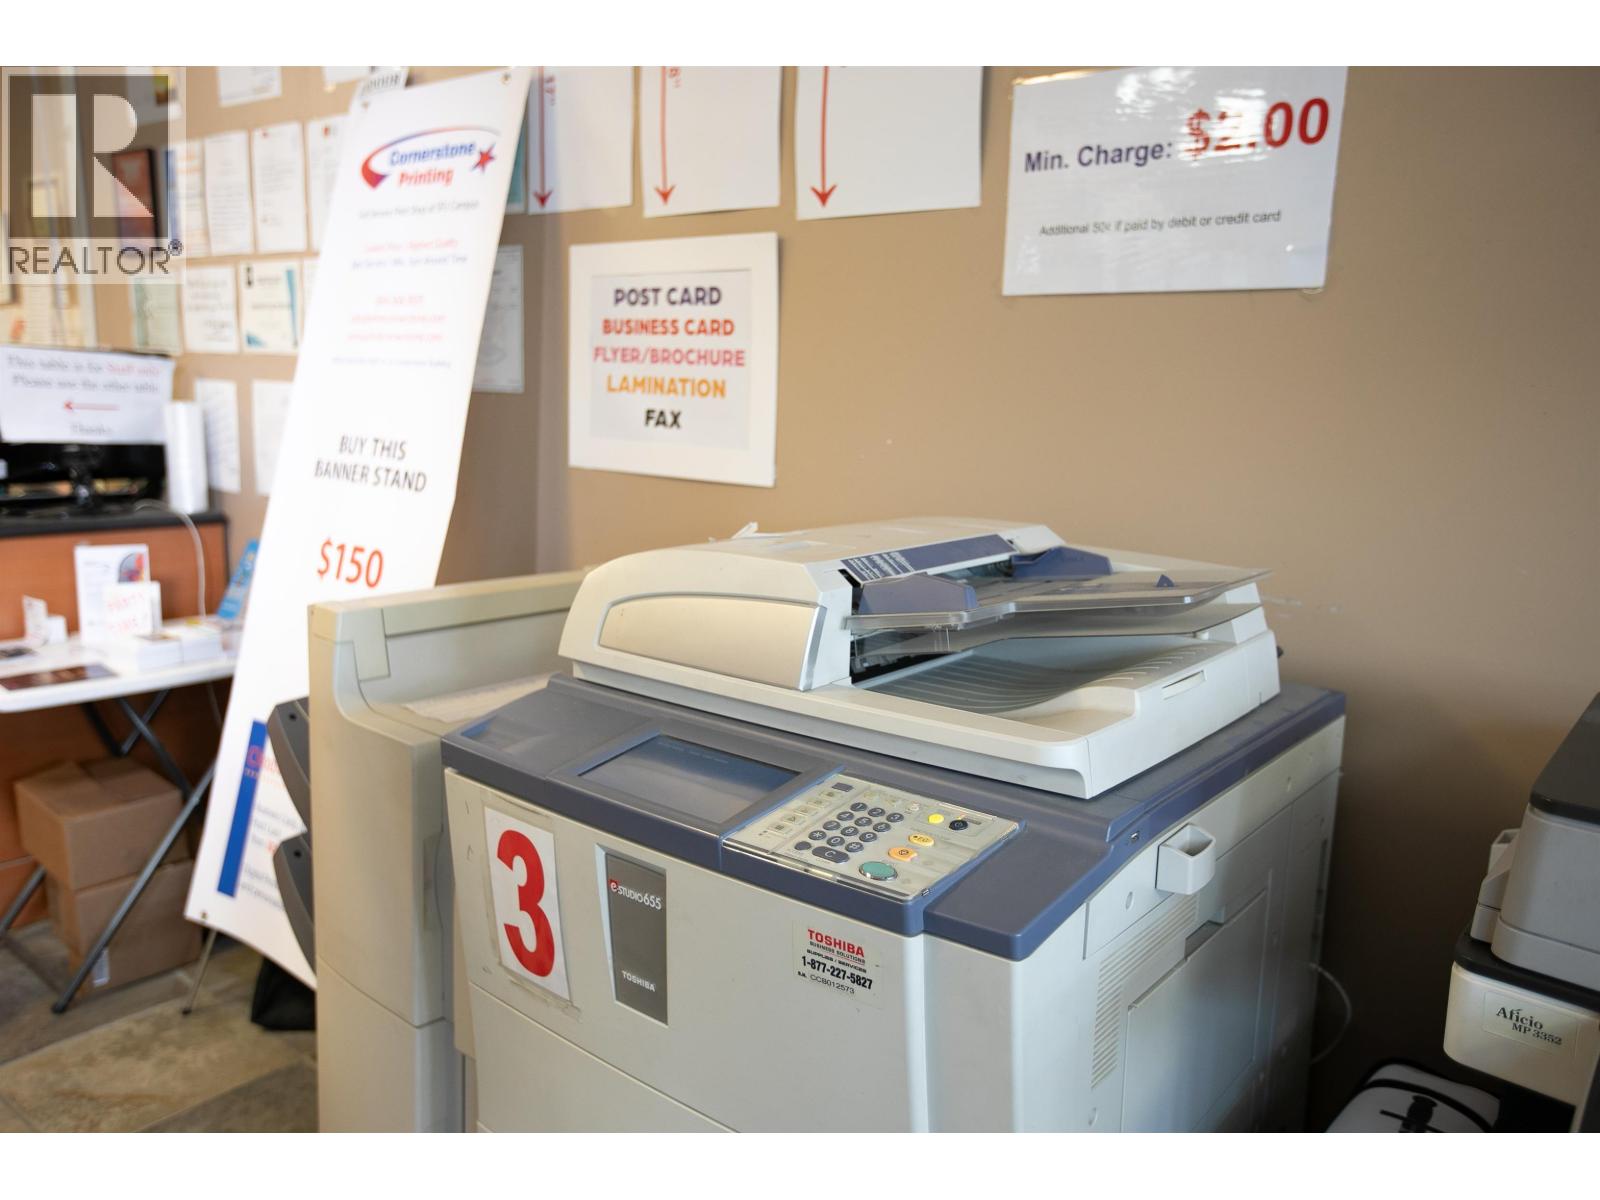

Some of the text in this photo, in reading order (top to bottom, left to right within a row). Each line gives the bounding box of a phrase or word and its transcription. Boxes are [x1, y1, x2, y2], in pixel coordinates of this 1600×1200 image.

[390, 142, 475, 166] Cornerstone
[1025, 151, 1069, 172] Min.
[1078, 141, 1173, 168] Charge:
[400, 169, 454, 187] Printing
[1150, 217, 1164, 231] by
[1168, 215, 1197, 228] debit
[1199, 217, 1212, 227] or
[1215, 212, 1250, 226] credit
[1253, 209, 1281, 223] card
[613, 286, 721, 306] POST CARD
[602, 318, 735, 336] BUSINESS CARD
[594, 347, 745, 367] FLYER/BROCHURE
[607, 375, 725, 397] LAMINATION
[645, 409, 681, 428] FAX
[340, 435, 406, 461] BUY THIS
[315, 459, 427, 492] BANNER STAND
[317, 537, 383, 588] $150
[497, 829, 555, 977] 3
[807, 929, 864, 957] TOSHIBA
[836, 949, 866, 964] SOLUTIONS
[621, 970, 656, 992] TOSHIBA
[801, 956, 873, 989] 1-877-227-5827
[1496, 1007, 1543, 1030] Aficio
[1511, 1022, 1562, 1046] MP 3352
